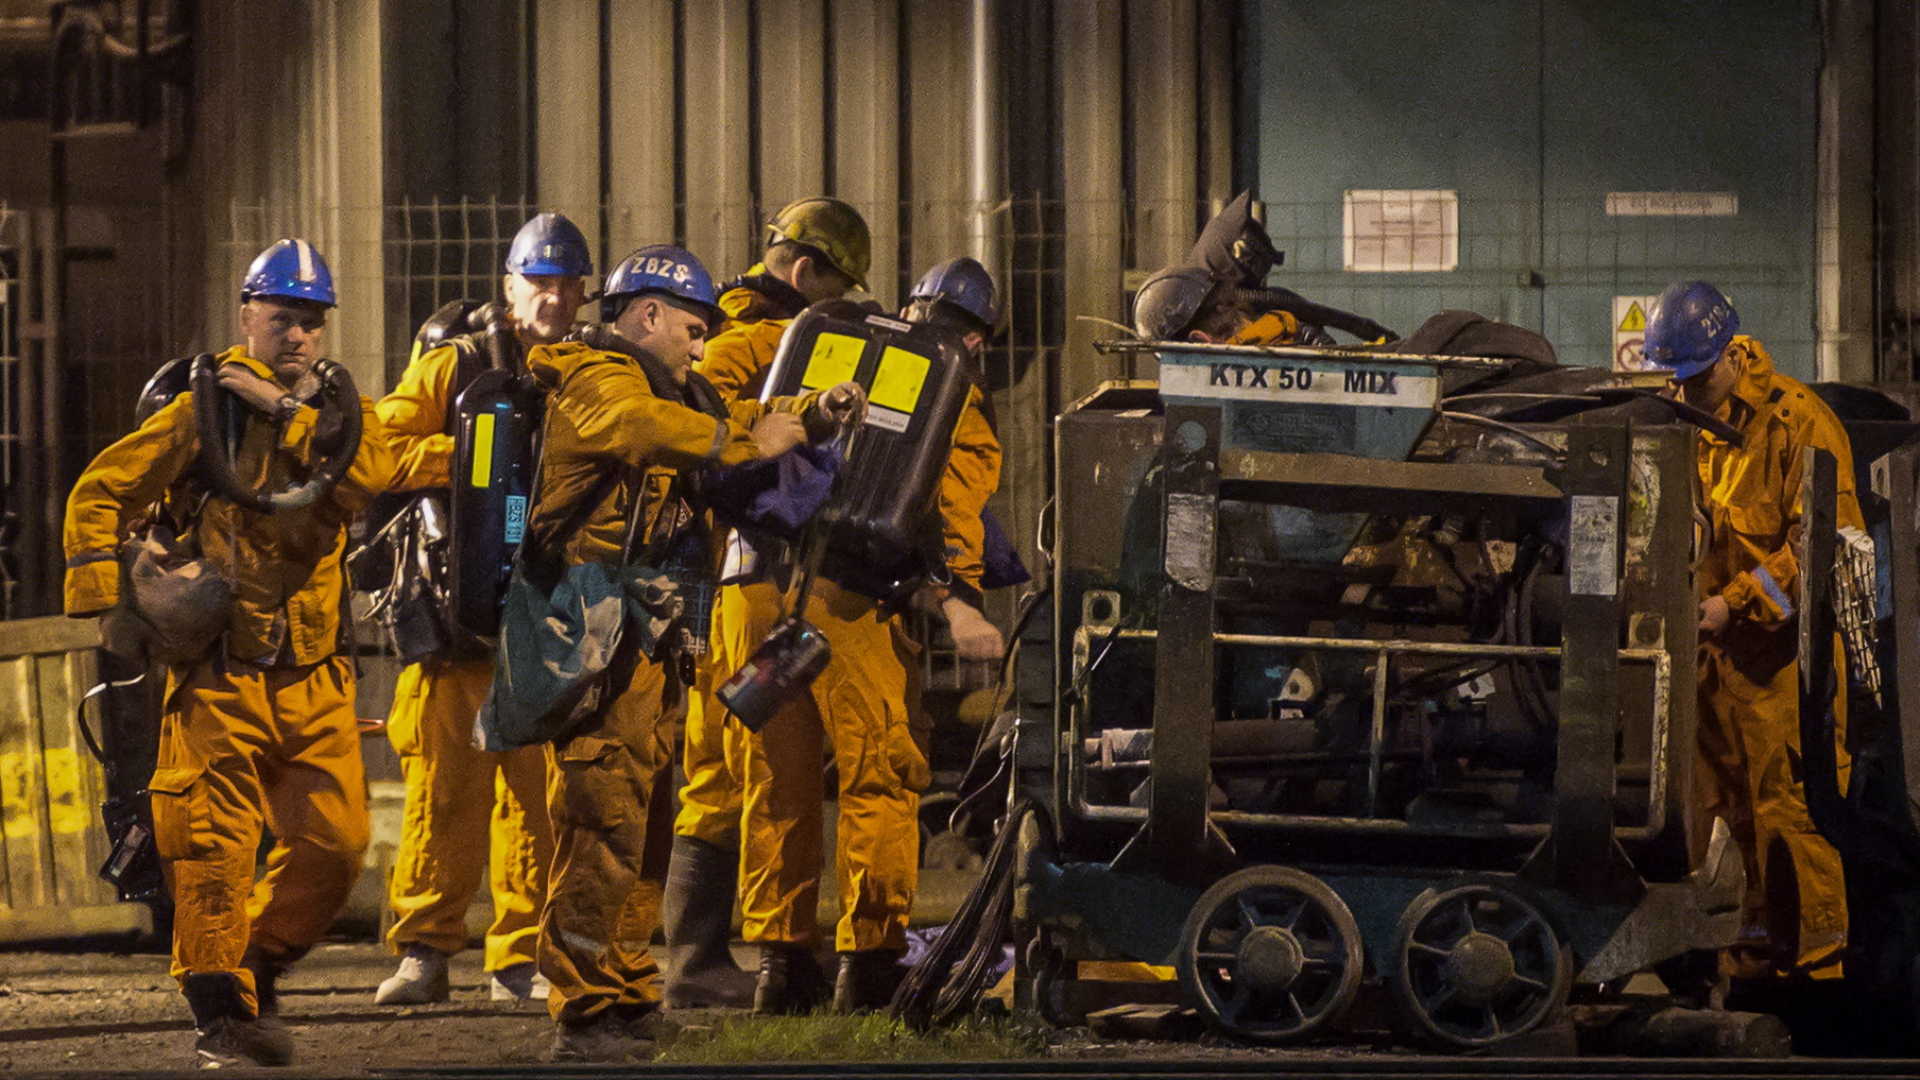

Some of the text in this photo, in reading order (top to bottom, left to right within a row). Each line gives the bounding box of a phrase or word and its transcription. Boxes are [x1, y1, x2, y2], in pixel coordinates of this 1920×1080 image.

[1209, 363, 1398, 395] KTX 50 MIX
